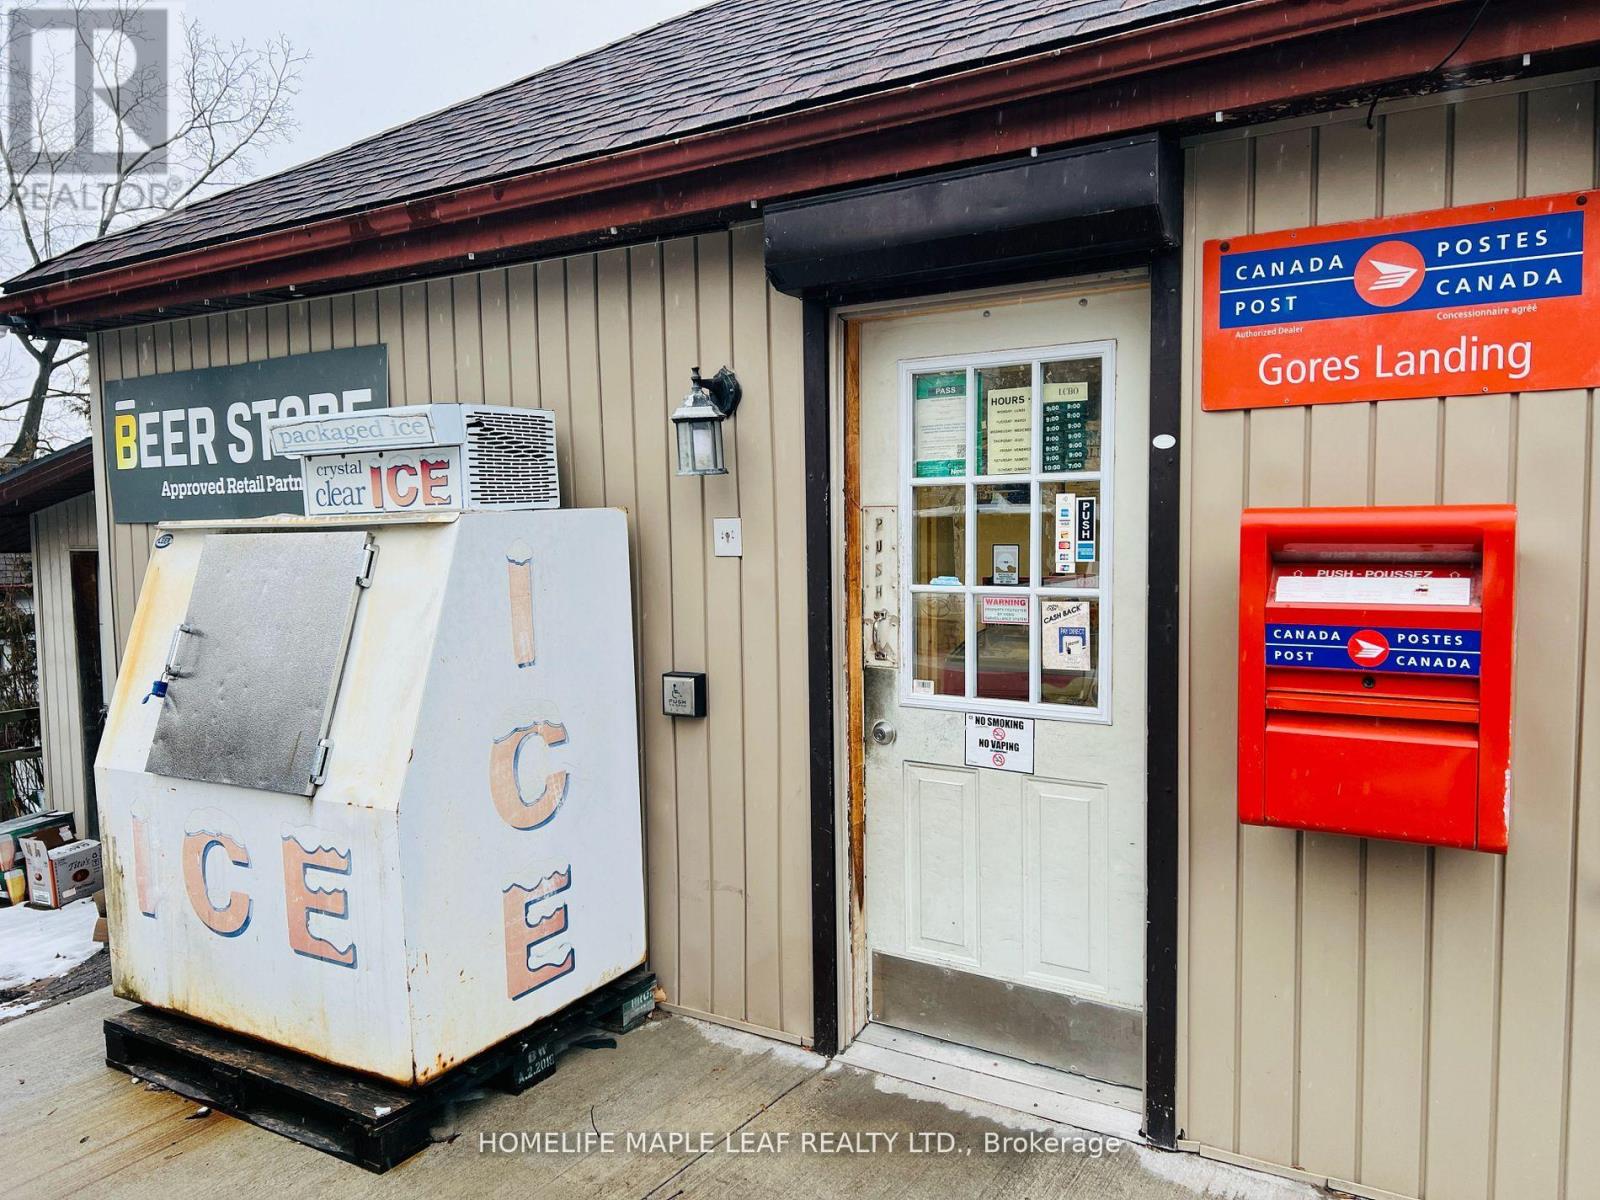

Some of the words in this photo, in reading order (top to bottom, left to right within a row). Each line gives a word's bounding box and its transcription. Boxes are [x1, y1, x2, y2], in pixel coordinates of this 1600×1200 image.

[1437, 229, 1548, 257] POSTES
[1235, 255, 1344, 281] CANADA
[1436, 268, 1563, 296] CANADA
[1235, 295, 1298, 315] POST
[1436, 306, 1510, 321] Concessionnaire
[1511, 303, 1538, 315] agréé
[1235, 327, 1277, 339] Authorized
[1278, 325, 1304, 335] Dealer
[1258, 352, 1360, 386] Gores
[1375, 335, 1532, 379] Landing
[935, 386, 956, 395] PASS
[1058, 387, 1079, 396] LCBO
[991, 395, 1025, 406] HOURS
[115, 400, 218, 470] BEER
[279, 419, 384, 449] packaged
[392, 417, 426, 436] ice
[316, 459, 363, 481] crystal
[161, 477, 225, 500] Approved
[227, 474, 265, 494] Retail
[315, 480, 366, 507] clear
[369, 455, 452, 509] ICE
[1081, 501, 1090, 539] PUSH
[874, 517, 884, 600] PUSH
[1316, 569, 1354, 578] PUSH
[1364, 569, 1434, 578] POUSSEZ
[985, 598, 1026, 607] WARNING
[1043, 611, 1062, 624] CASH
[1062, 605, 1081, 617] BACK
[1273, 629, 1341, 641] CANADA
[1397, 633, 1463, 646] POSTES
[1274, 650, 1314, 661] POST
[1396, 655, 1471, 669] CANADA
[975, 715, 986, 726] NO
[987, 717, 1024, 730] SMOKING
[978, 738, 990, 748] NO
[991, 739, 1020, 752] VAPING
[490, 540, 576, 1002] ICE
[131, 810, 358, 970] ICE
